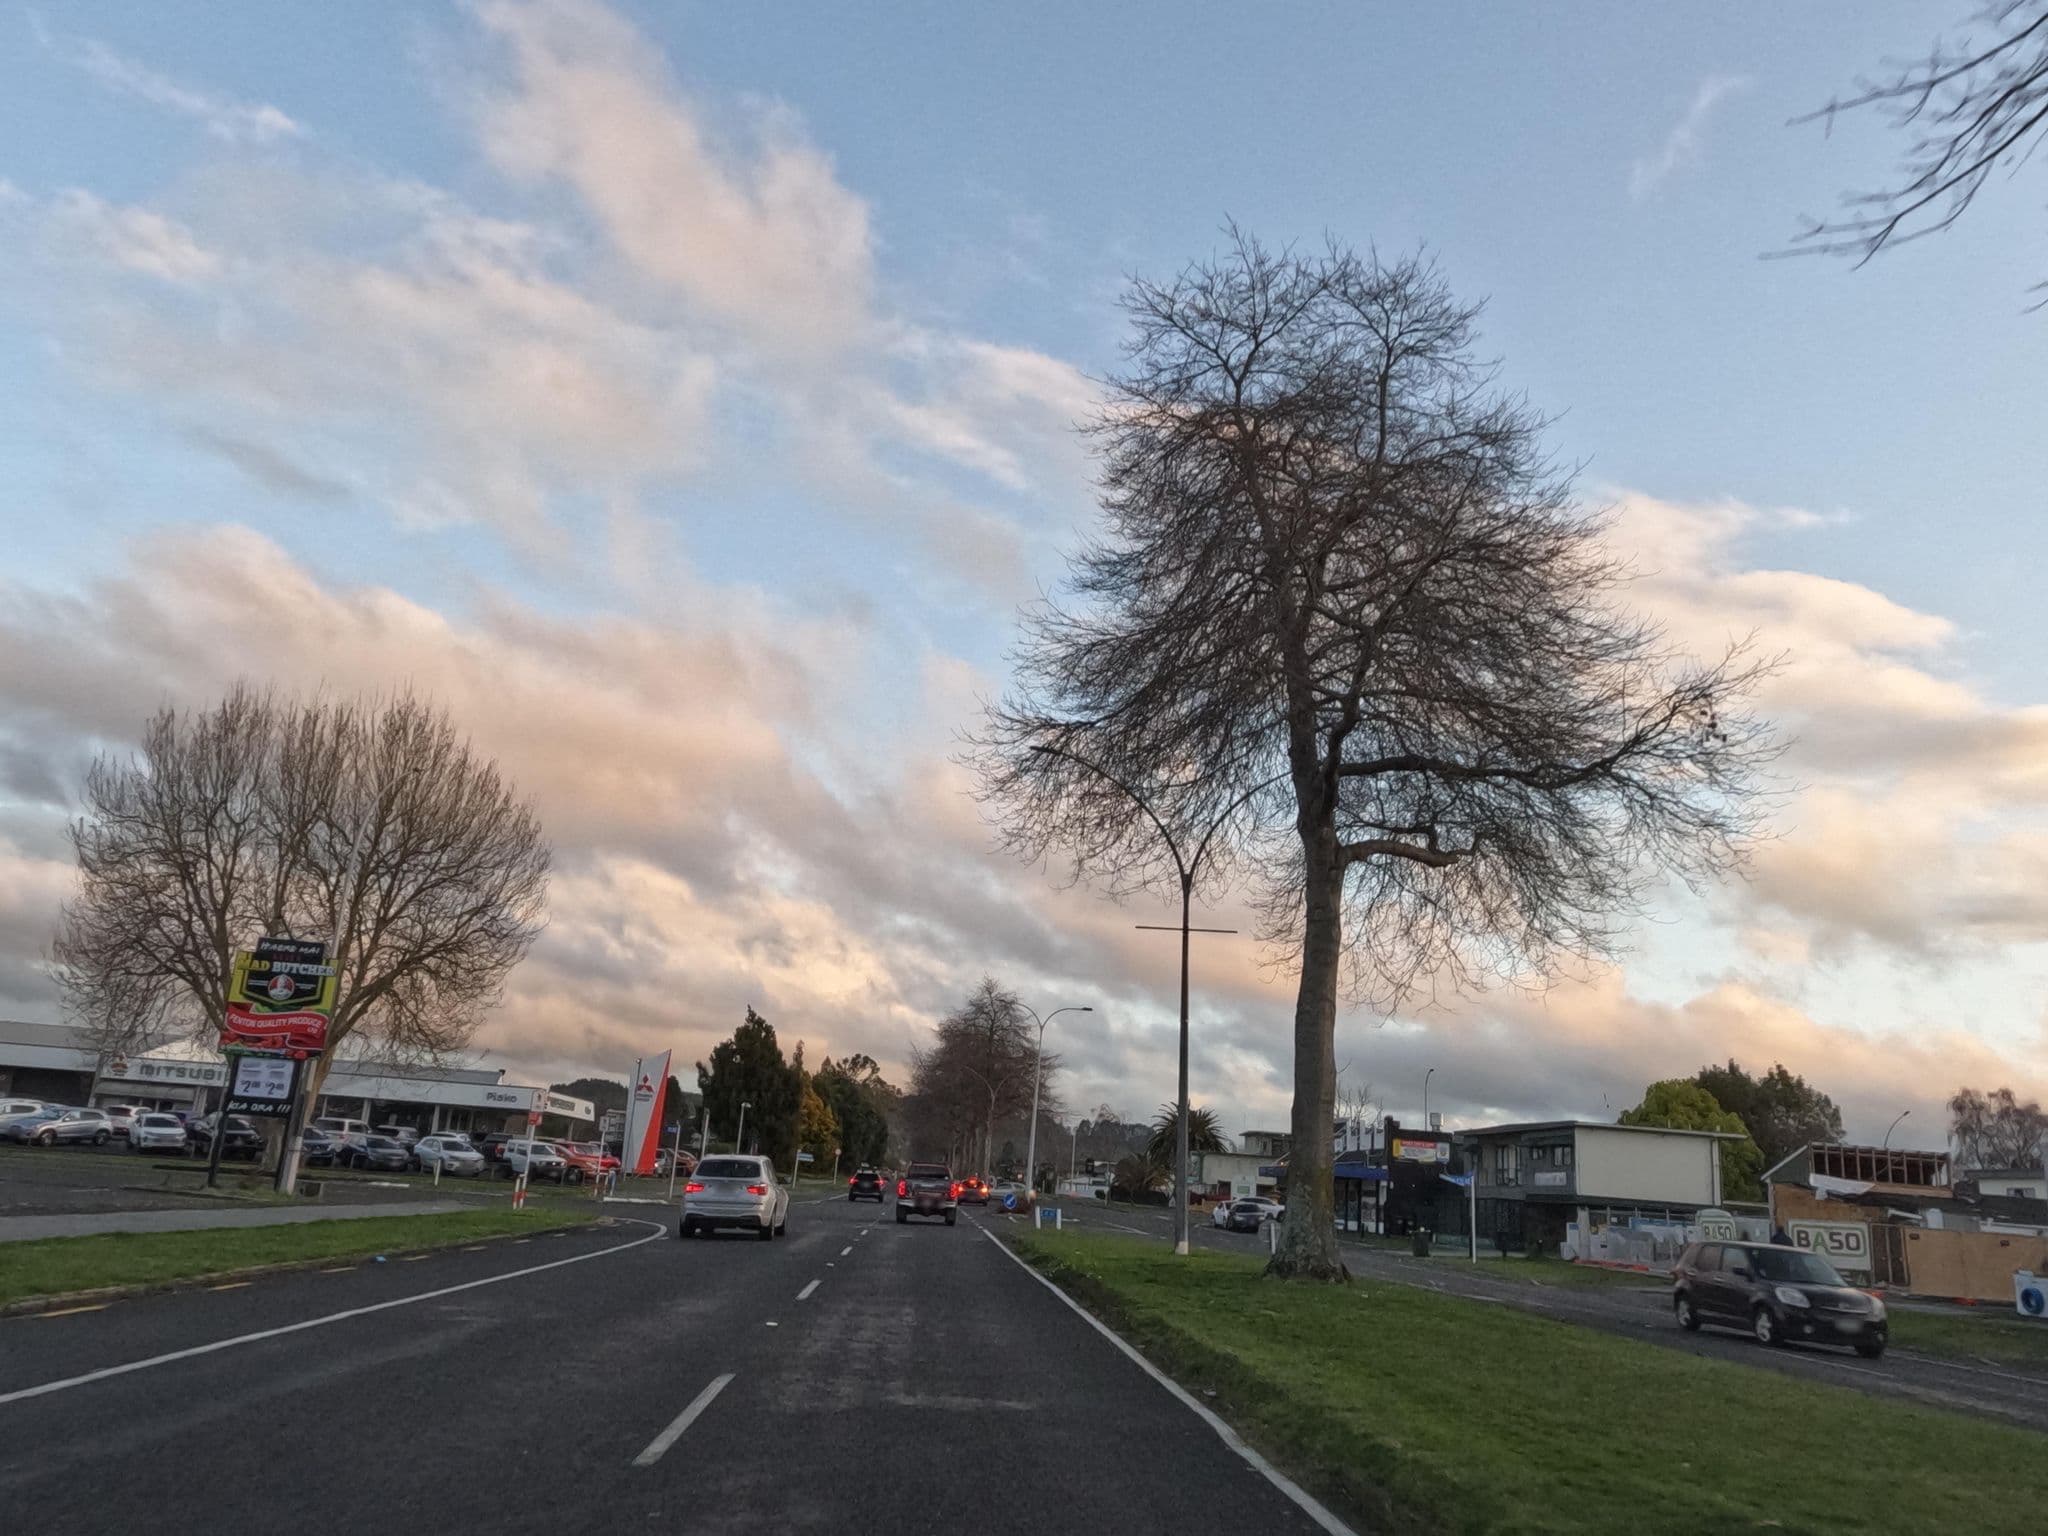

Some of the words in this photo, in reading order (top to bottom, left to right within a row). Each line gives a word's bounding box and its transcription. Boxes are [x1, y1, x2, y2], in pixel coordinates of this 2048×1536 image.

[271, 961, 335, 977] BUTCHER
[257, 1018, 287, 1028] QUALITY
[287, 1016, 322, 1028] PRODUCE
[140, 1063, 224, 1081] MITSUBI
[226, 1100, 248, 1112] KIA
[250, 1102, 274, 1112] ORA
[1796, 1229, 1861, 1251] BASO
